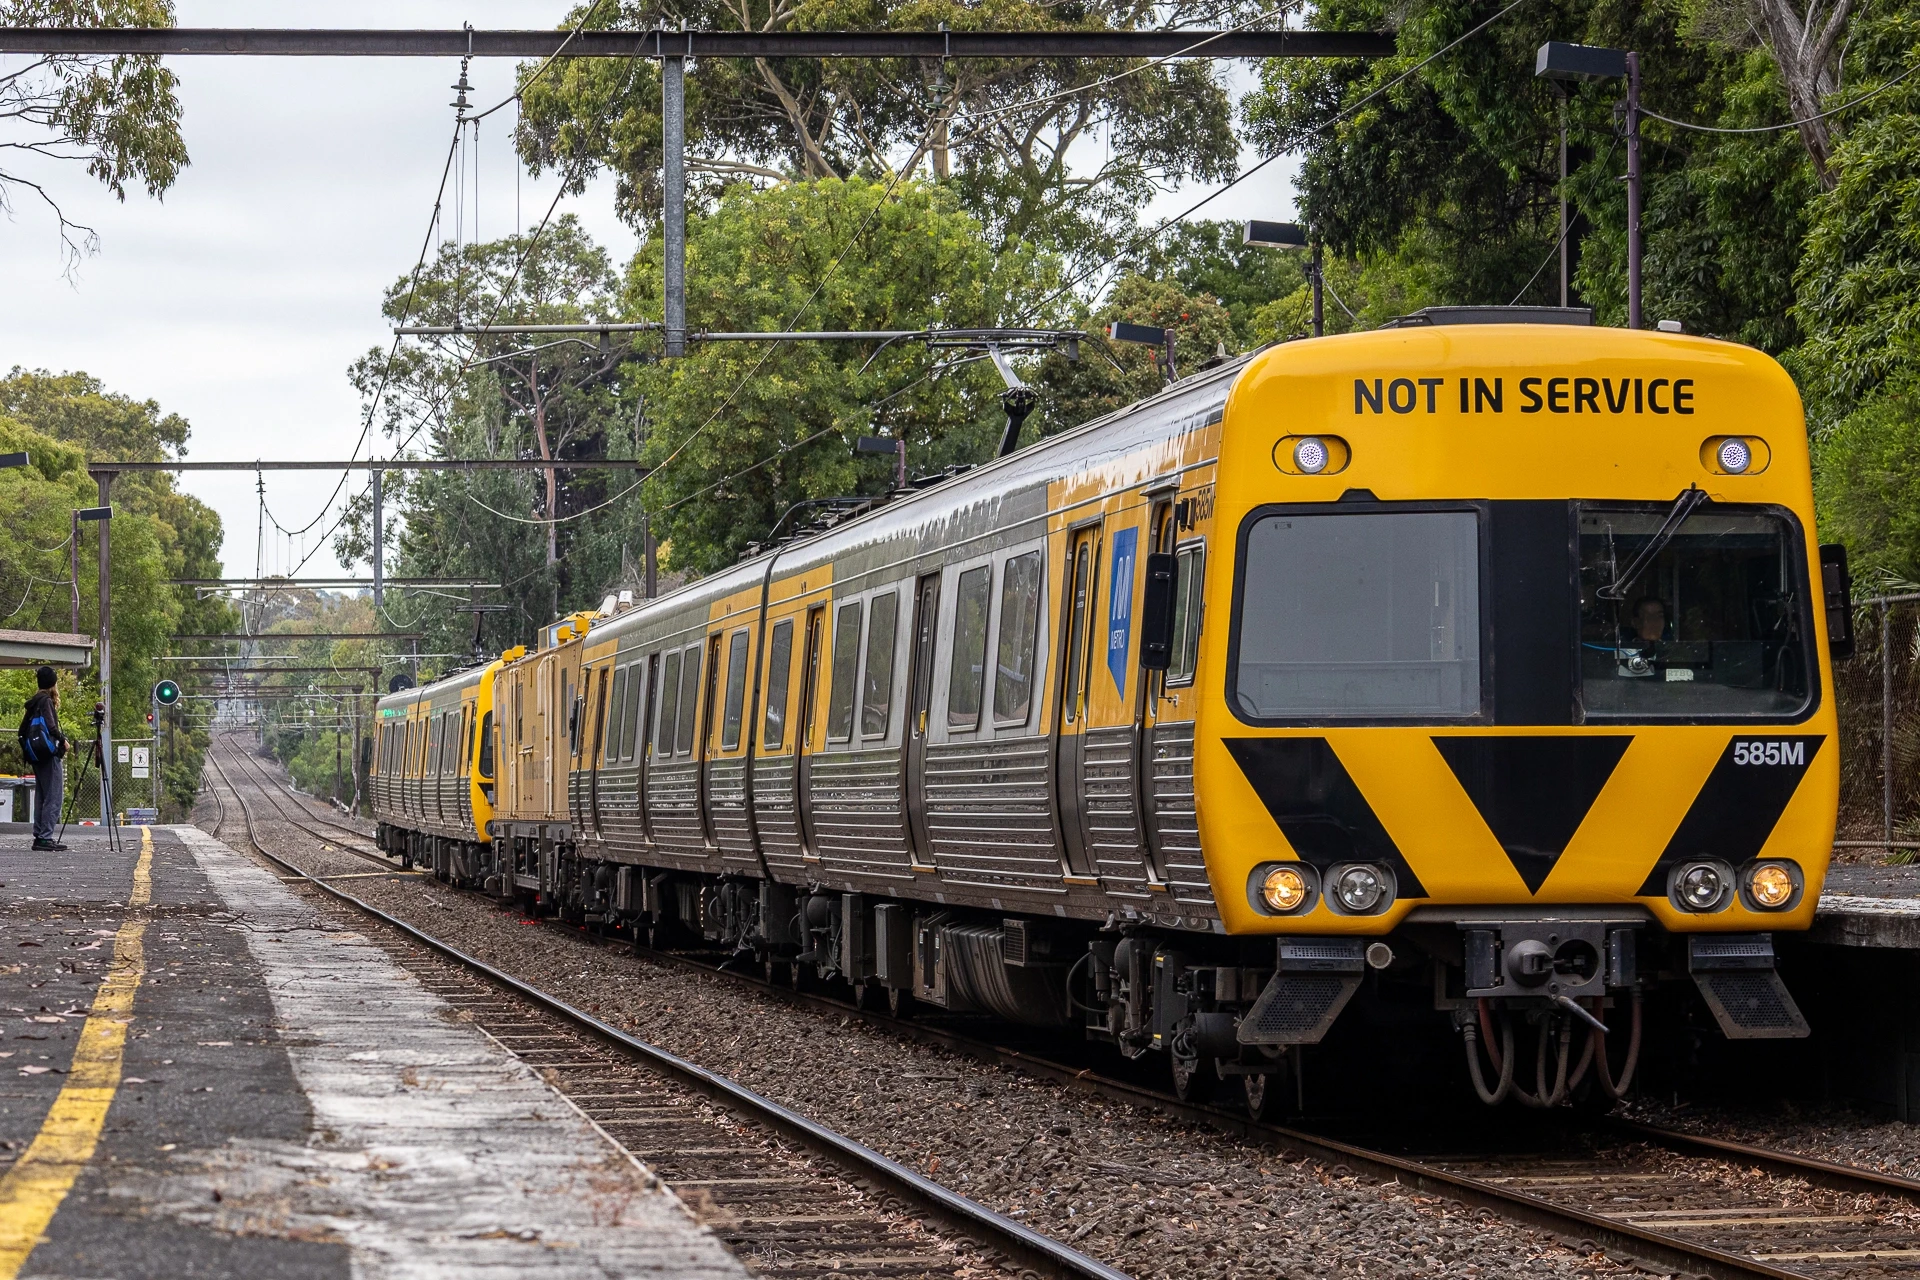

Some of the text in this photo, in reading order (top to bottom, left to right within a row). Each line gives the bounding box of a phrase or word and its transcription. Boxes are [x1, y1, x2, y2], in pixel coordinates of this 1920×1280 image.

[1354, 377, 1695, 414] NOT IN SERVICE
[1109, 628, 1125, 650] METRO
[1733, 741, 1804, 765] 585M
